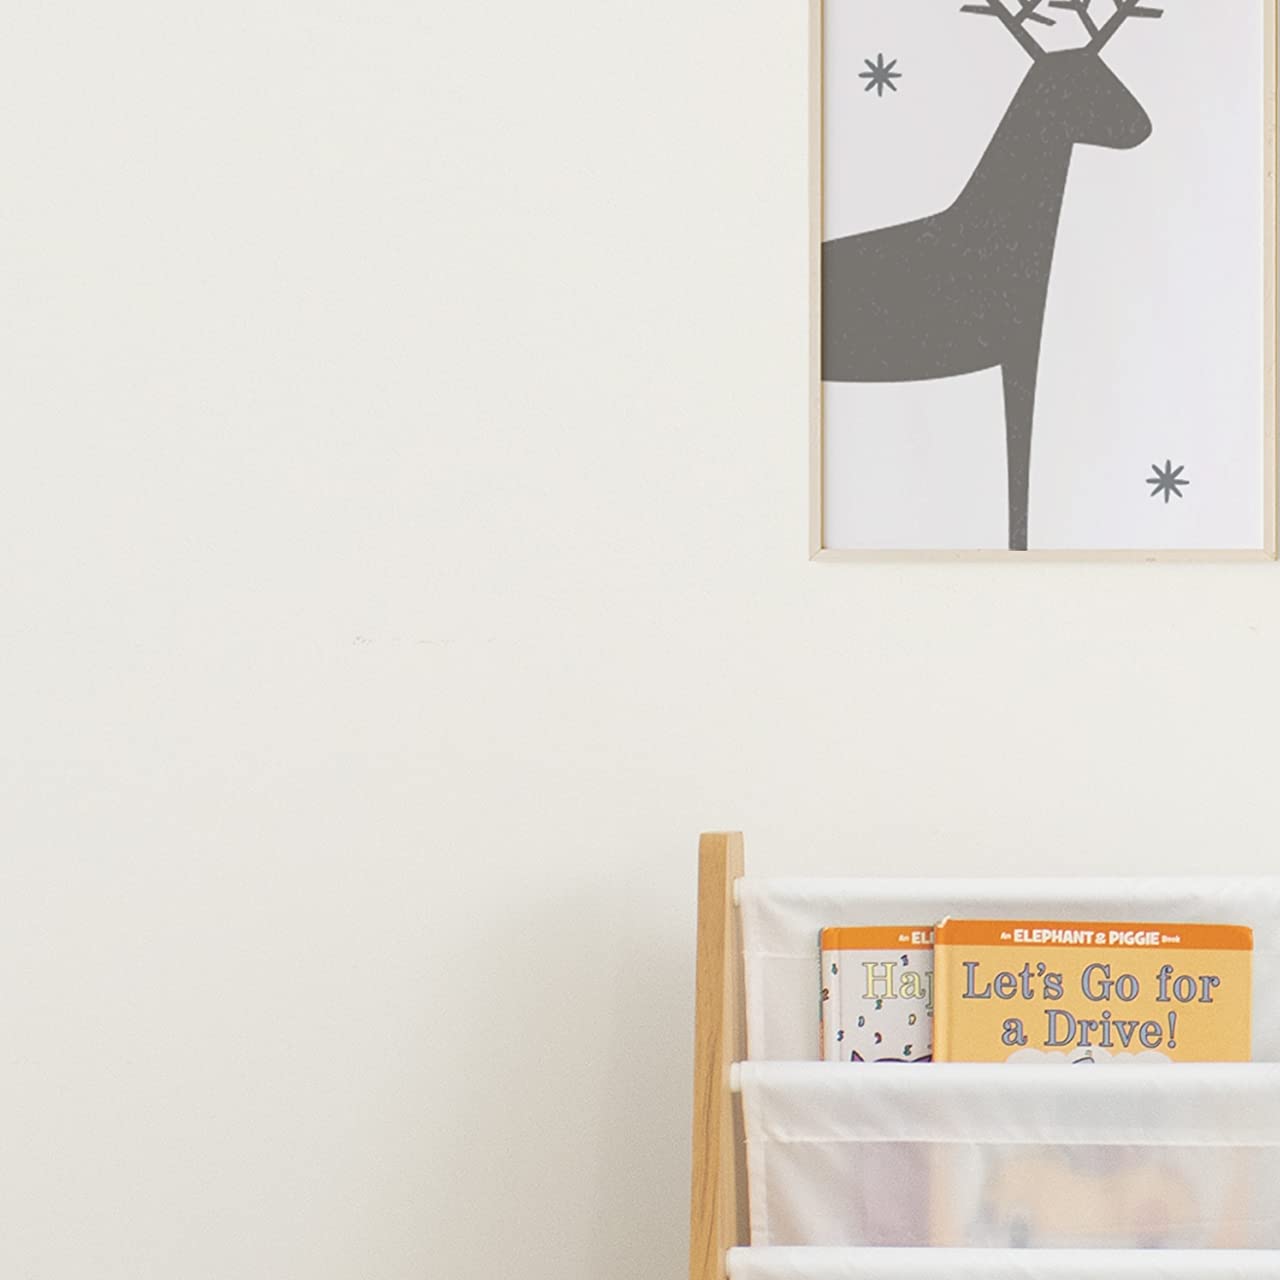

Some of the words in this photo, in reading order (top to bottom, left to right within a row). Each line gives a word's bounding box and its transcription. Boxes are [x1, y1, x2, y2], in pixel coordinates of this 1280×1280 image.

[1013, 929, 1095, 945] ELEPHANT
[1095, 932, 1106, 944] &
[1109, 931, 1160, 945] PIGGIE
[1161, 935, 1181, 943] Book
[962, 961, 1064, 1000] Let’s
[1081, 963, 1139, 1001] Go
[1155, 964, 1221, 1003] for
[1001, 1017, 1028, 1046] a
[1044, 1009, 1178, 1048] Drive!
